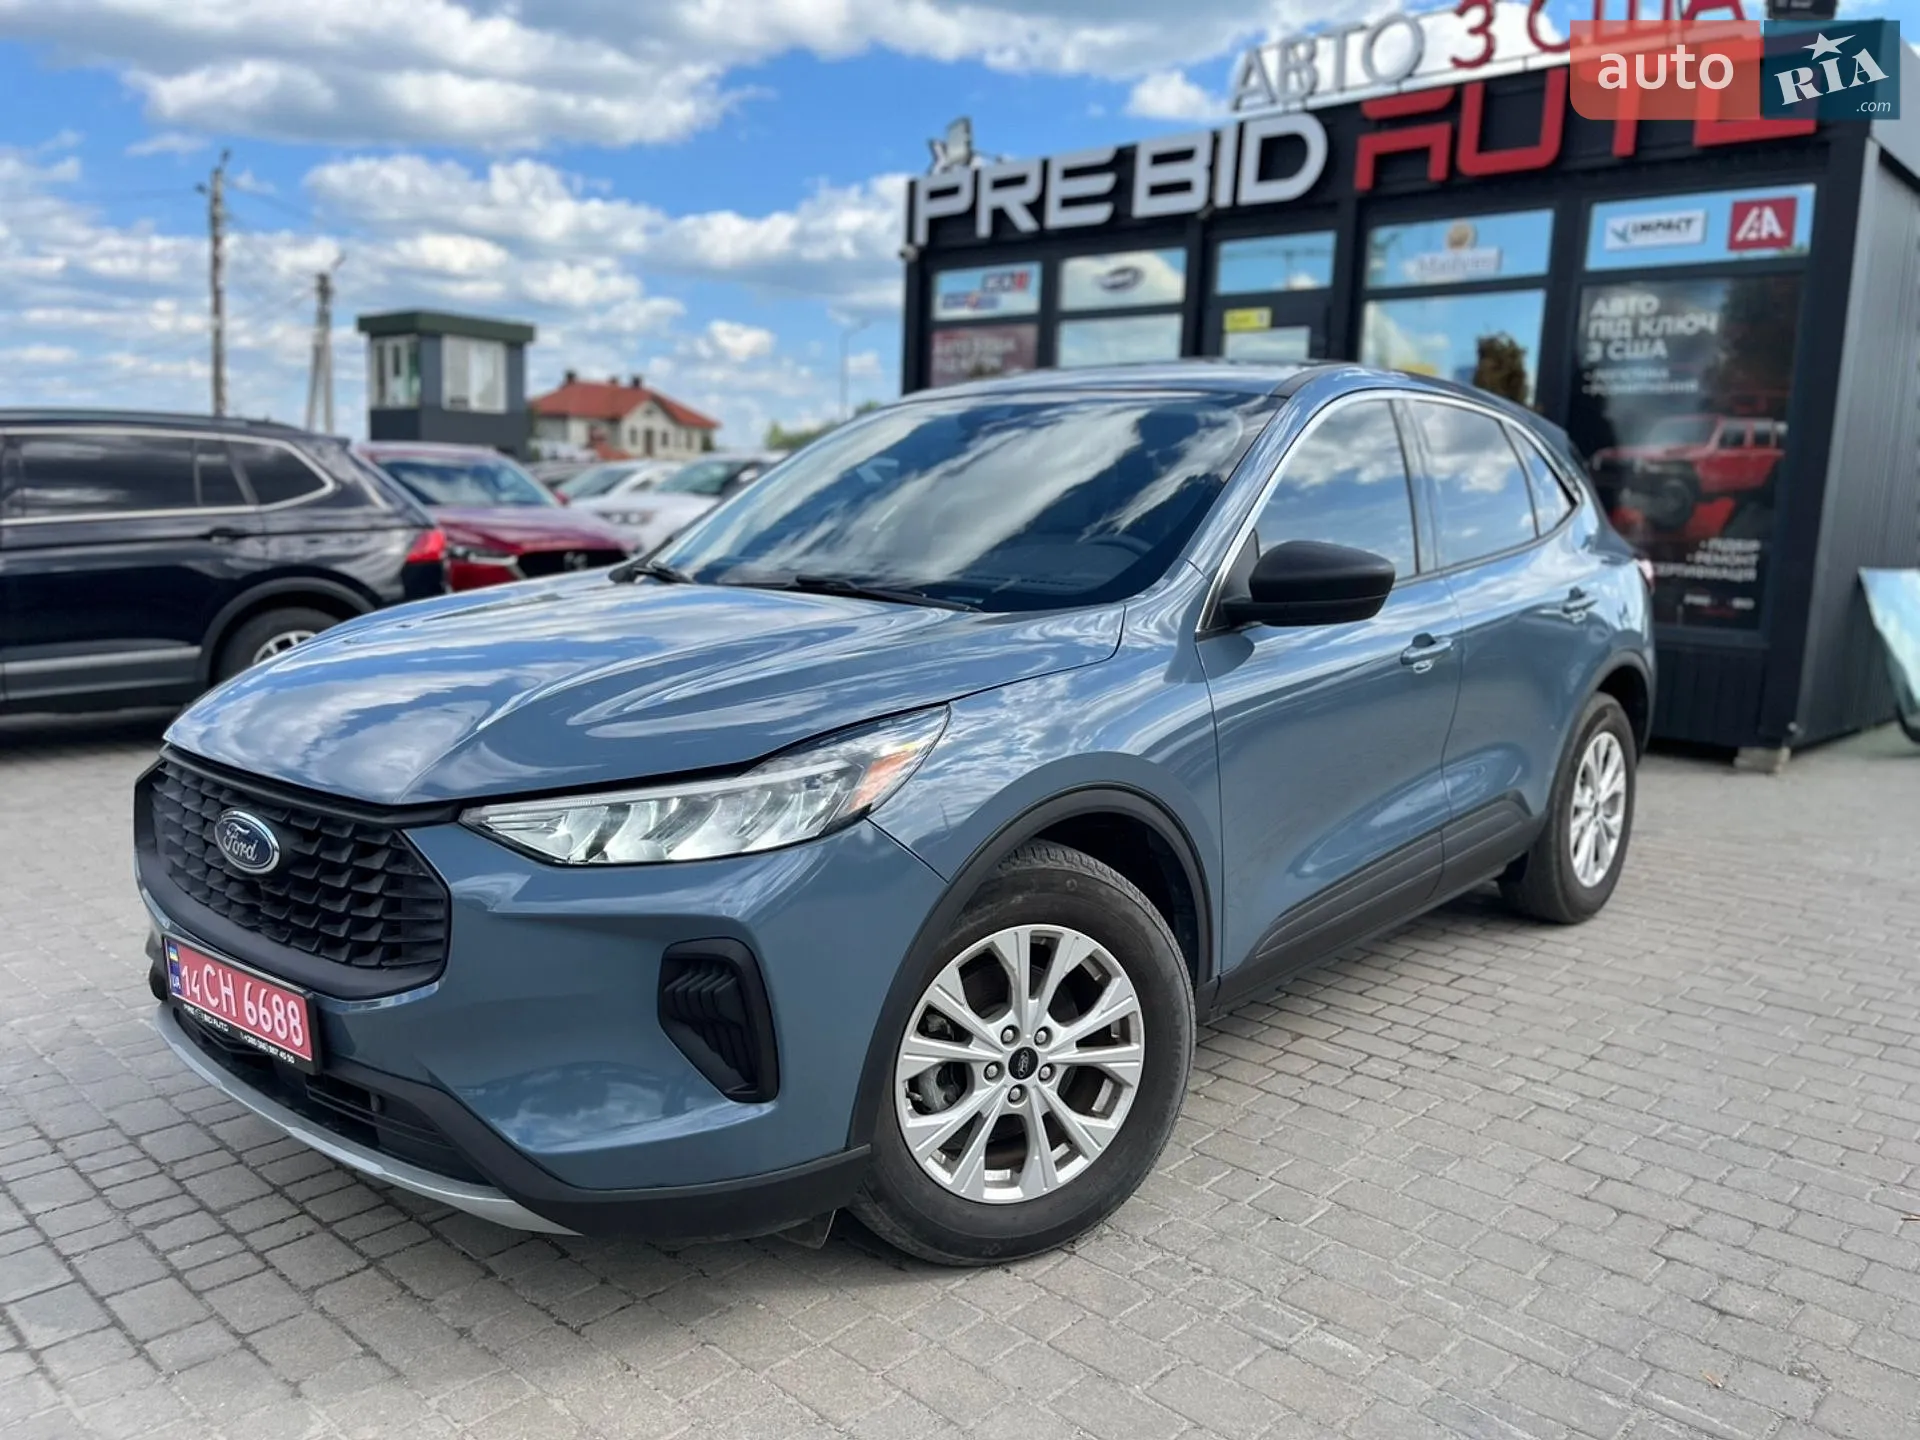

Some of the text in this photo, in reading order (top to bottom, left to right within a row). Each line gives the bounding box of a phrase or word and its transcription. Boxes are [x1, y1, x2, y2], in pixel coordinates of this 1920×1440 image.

[1231, 13, 1425, 112] АВТО
[914, 146, 1118, 246] PRE
[1131, 112, 1328, 219] BID
[1589, 294, 1660, 318] АВТО
[1588, 312, 1719, 340] ПІД КЛЮЧ
[1607, 338, 1669, 360] США
[223, 822, 259, 861] Ford
[244, 982, 304, 1048] 6688
